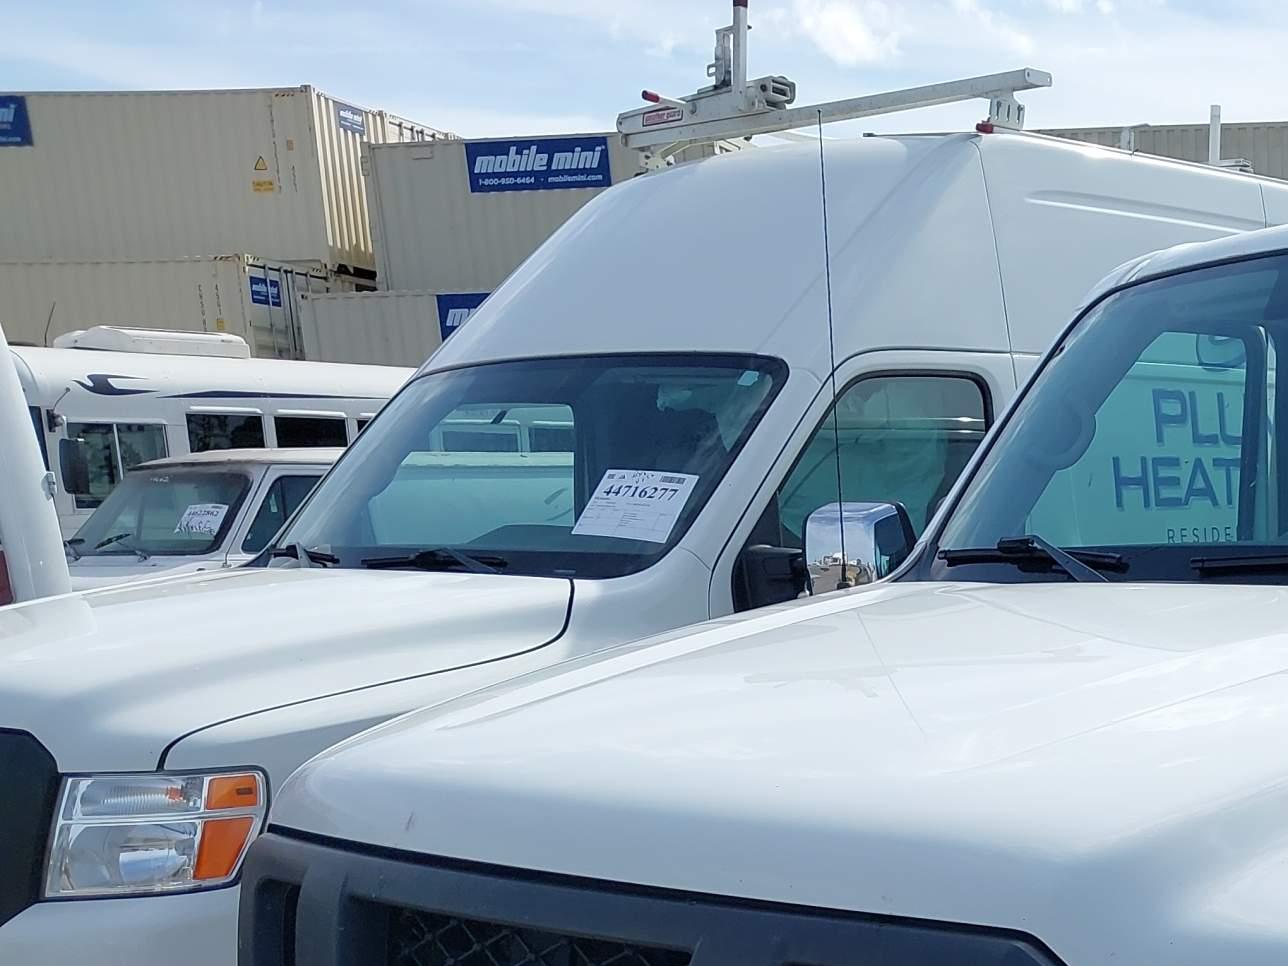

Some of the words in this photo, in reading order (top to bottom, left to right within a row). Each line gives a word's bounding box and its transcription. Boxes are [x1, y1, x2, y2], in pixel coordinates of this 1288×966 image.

[474, 145, 548, 173] mobile
[551, 146, 602, 170] mini
[548, 174, 602, 183] mobilemini.com
[603, 484, 679, 501] 44716277
